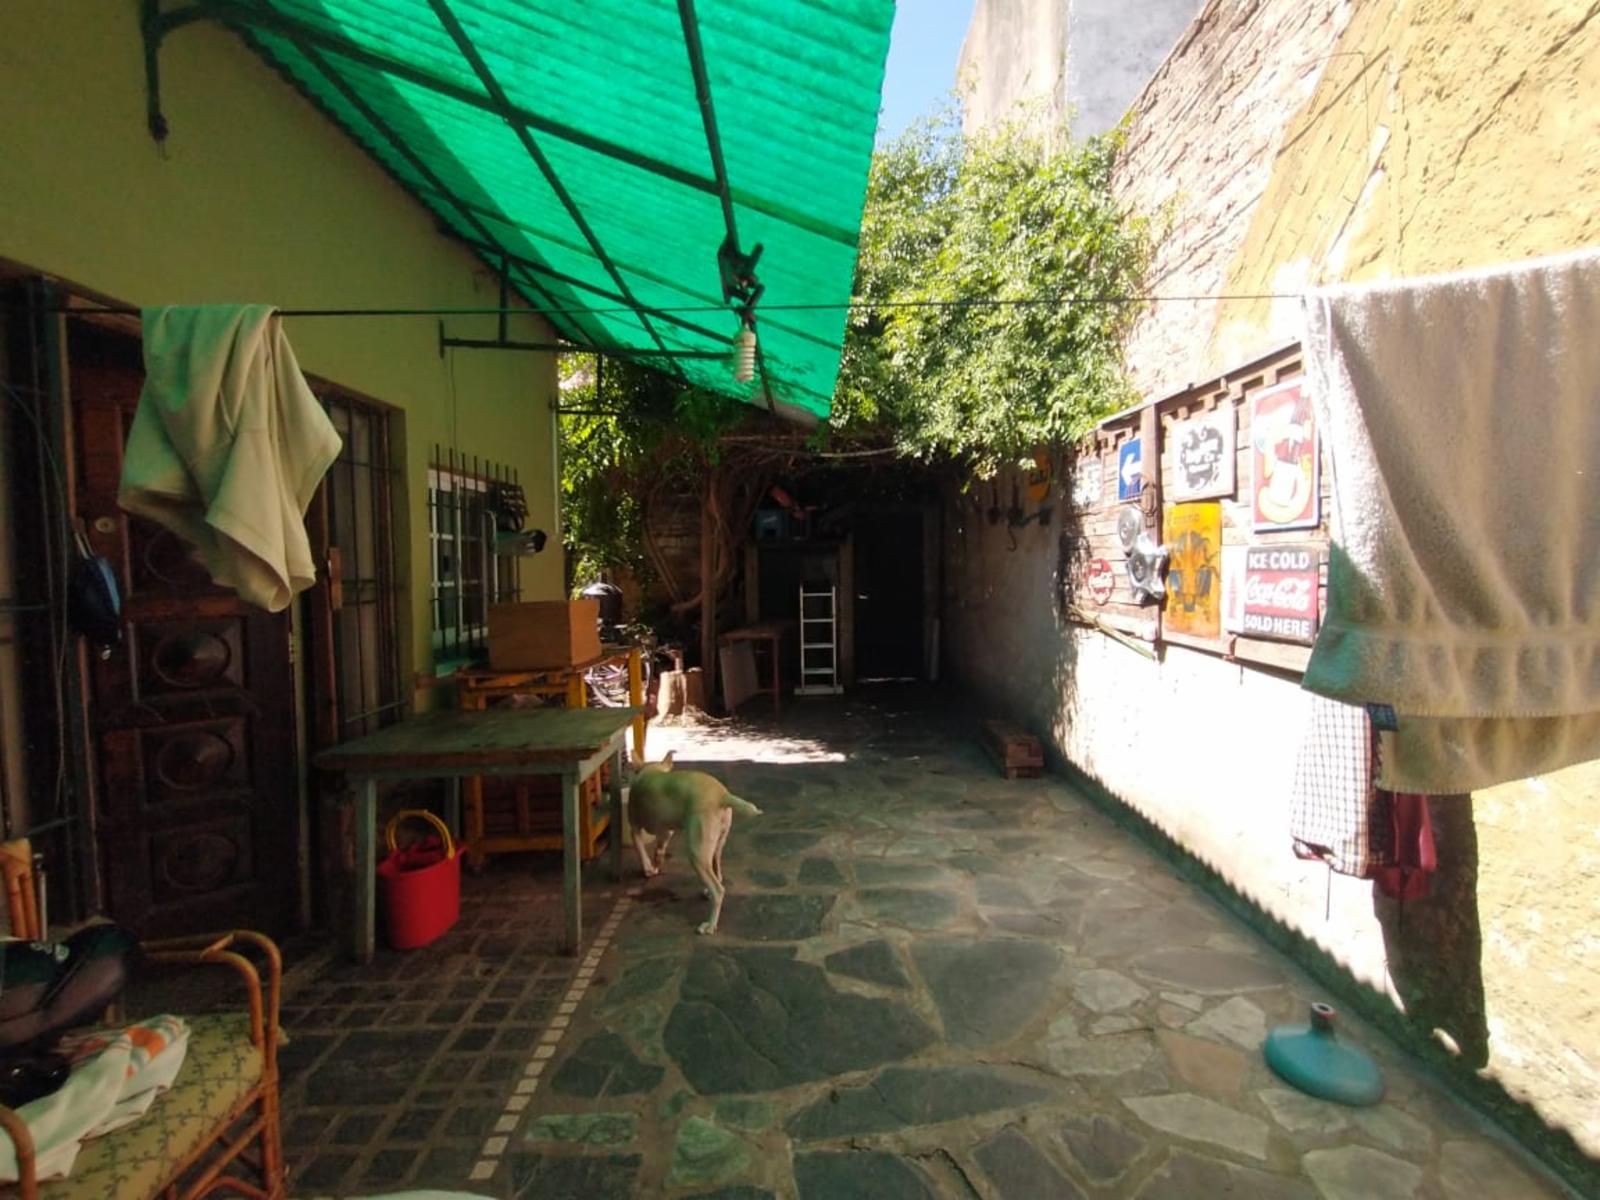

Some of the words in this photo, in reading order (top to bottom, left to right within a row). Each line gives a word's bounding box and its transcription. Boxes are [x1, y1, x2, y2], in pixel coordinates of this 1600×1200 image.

[1249, 553, 1267, 569] ICE
[1270, 552, 1308, 569] COLD
[1246, 575, 1311, 612] Coca-Cola
[1245, 614, 1273, 631] SOLD
[1274, 617, 1310, 637] HERE
